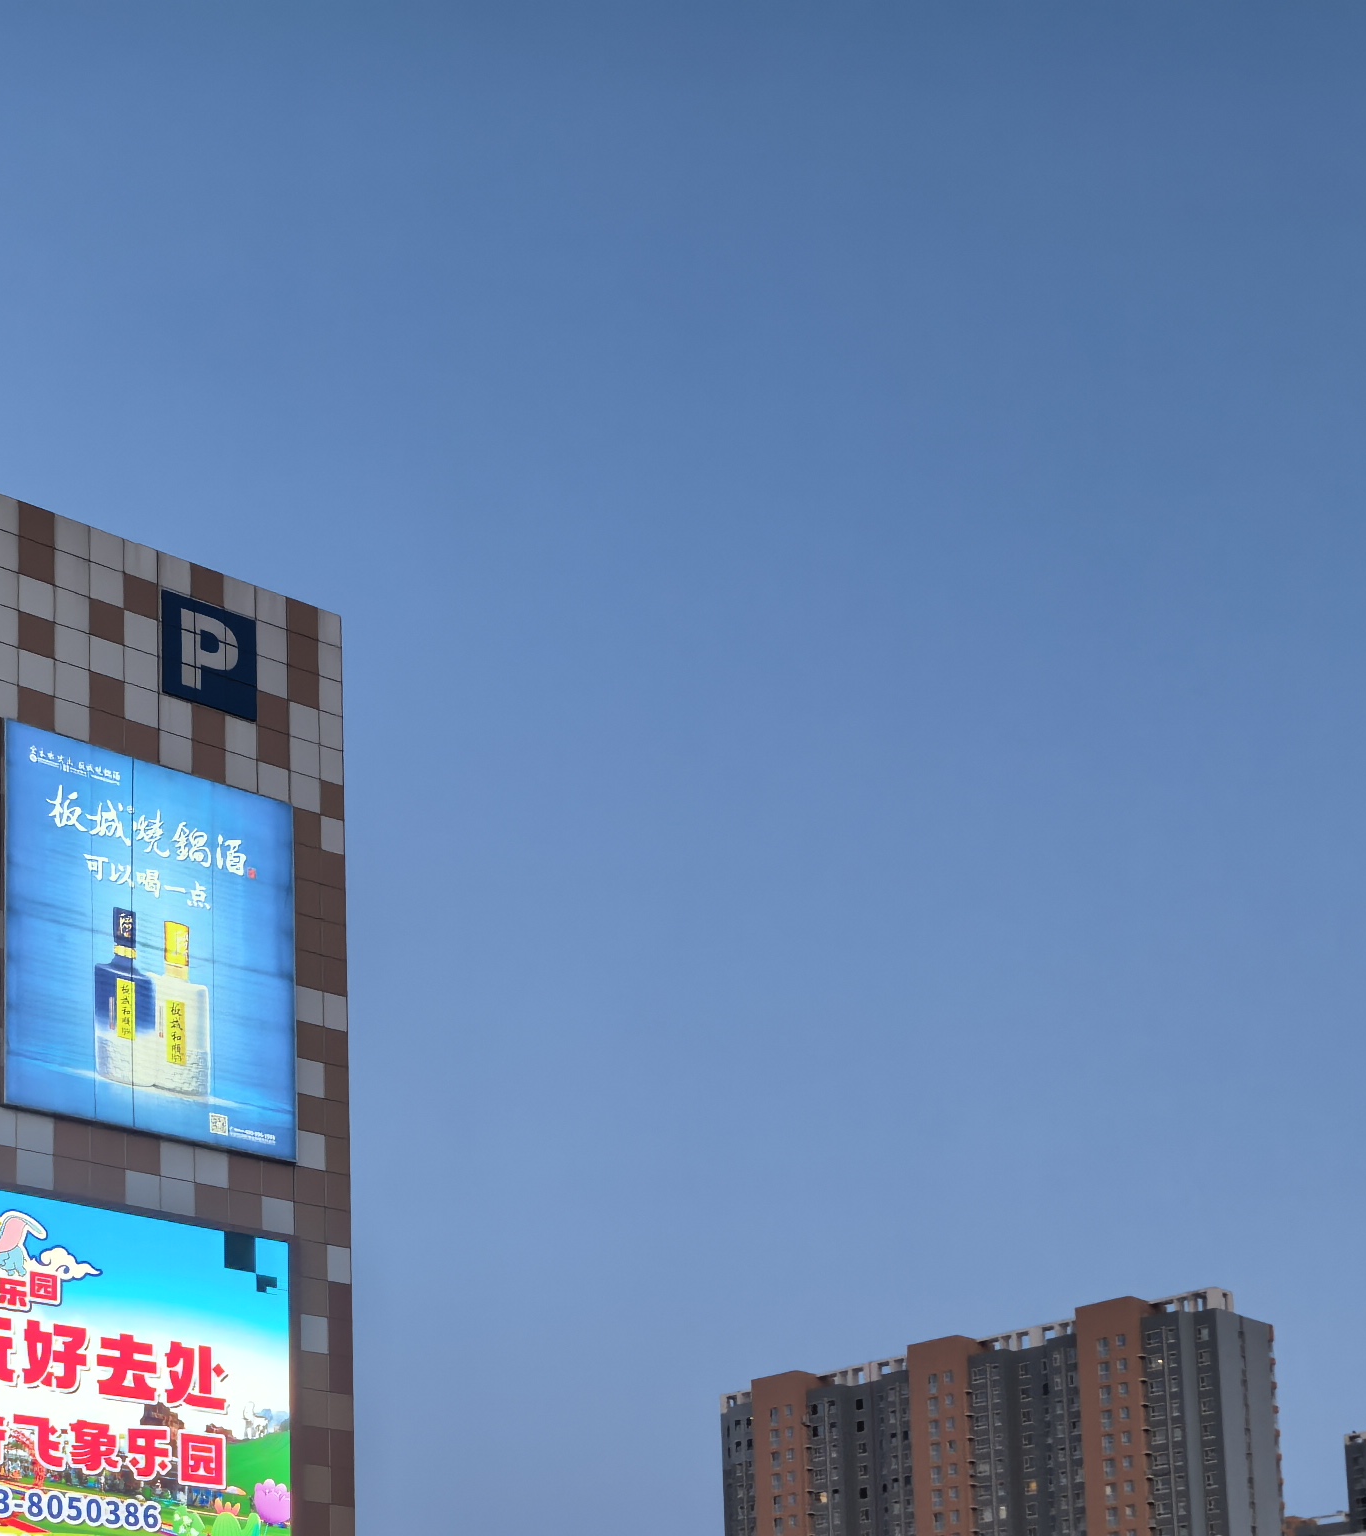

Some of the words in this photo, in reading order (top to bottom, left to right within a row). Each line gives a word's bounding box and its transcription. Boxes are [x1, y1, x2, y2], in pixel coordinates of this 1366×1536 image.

[181, 606, 239, 691] P
[83, 853, 211, 910] 可以喝一点
